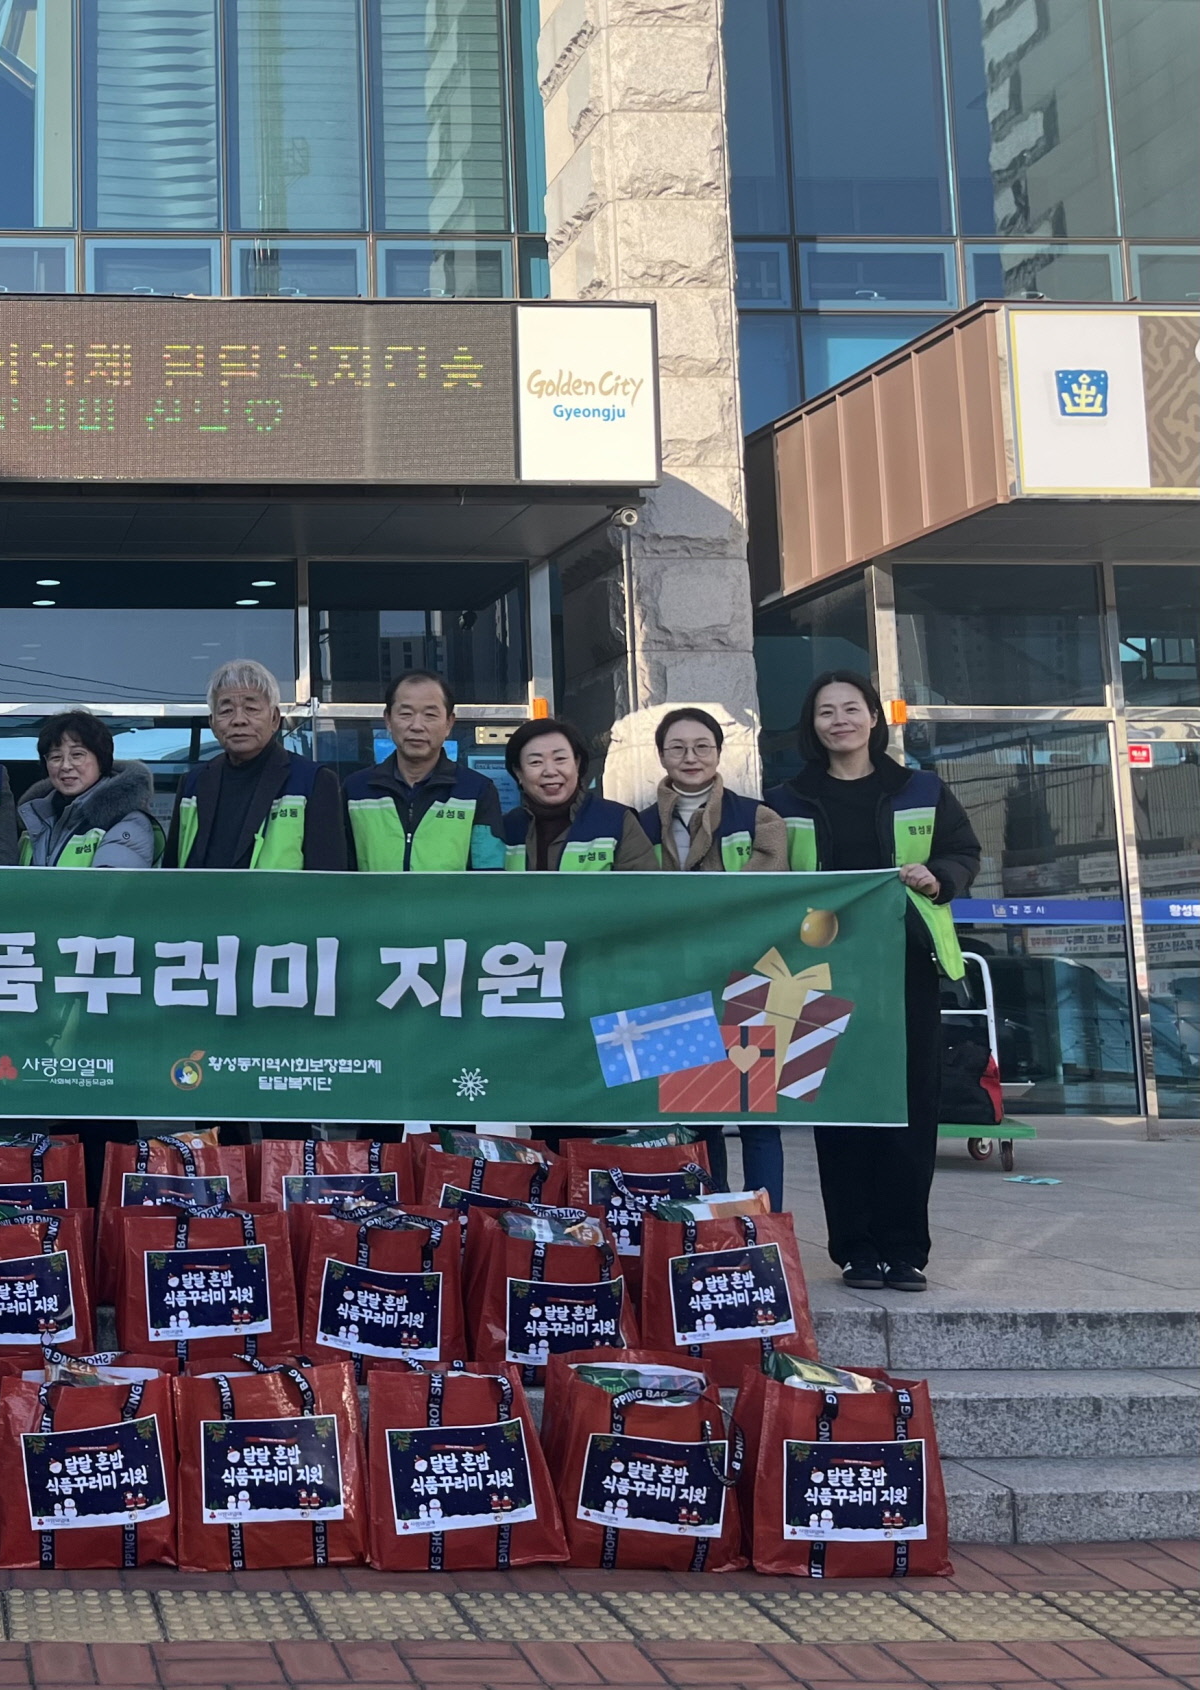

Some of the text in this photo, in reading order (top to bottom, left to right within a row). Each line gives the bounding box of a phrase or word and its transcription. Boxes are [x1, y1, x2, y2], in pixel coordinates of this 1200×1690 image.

[527, 368, 645, 413] Golden City
[552, 403, 627, 423] Gyeongju
[376, 938, 569, 1020] 지원
[21, 1056, 114, 1077] 사랑의열매
[208, 1055, 383, 1075] 황성동지역사회보장협의체
[257, 1075, 333, 1092] 달달복지단
[177, 1224, 187, 1248] BAG
[13, 1280, 39, 1298] 혼밥
[181, 1270, 234, 1289] 달달 혼밥
[705, 1270, 755, 1293] 달달 혼밥
[34, 1295, 59, 1313] 지원
[163, 1286, 254, 1308] 식품꾸러미 지원
[357, 1290, 409, 1311] 달달 혼밥
[688, 1286, 776, 1311] 식품꾸러미 지원
[337, 1302, 425, 1329] 식품꾸러미 지원
[545, 1304, 598, 1321] 달달 혼밥
[524, 1319, 615, 1337] 식품꾸러미 지원
[646, 1390, 669, 1398] BAG
[65, 1449, 124, 1476] 달달 혼밥
[243, 1444, 301, 1466] 달달 혼밥
[430, 1451, 491, 1475] 달달 혼밥
[46, 1465, 149, 1496] 식품꾸러미 지원
[221, 1464, 324, 1487] 식품꾸러미 지원
[411, 1468, 514, 1496] 식품꾸러미 지원
[628, 1460, 689, 1485] 달달 혼밥
[827, 1466, 887, 1487] 달달 혼밥
[602, 1475, 707, 1505] 식품꾸러미 지원
[804, 1486, 908, 1506] 식품꾸러미 지원
[42, 1532, 52, 1561] BAG
